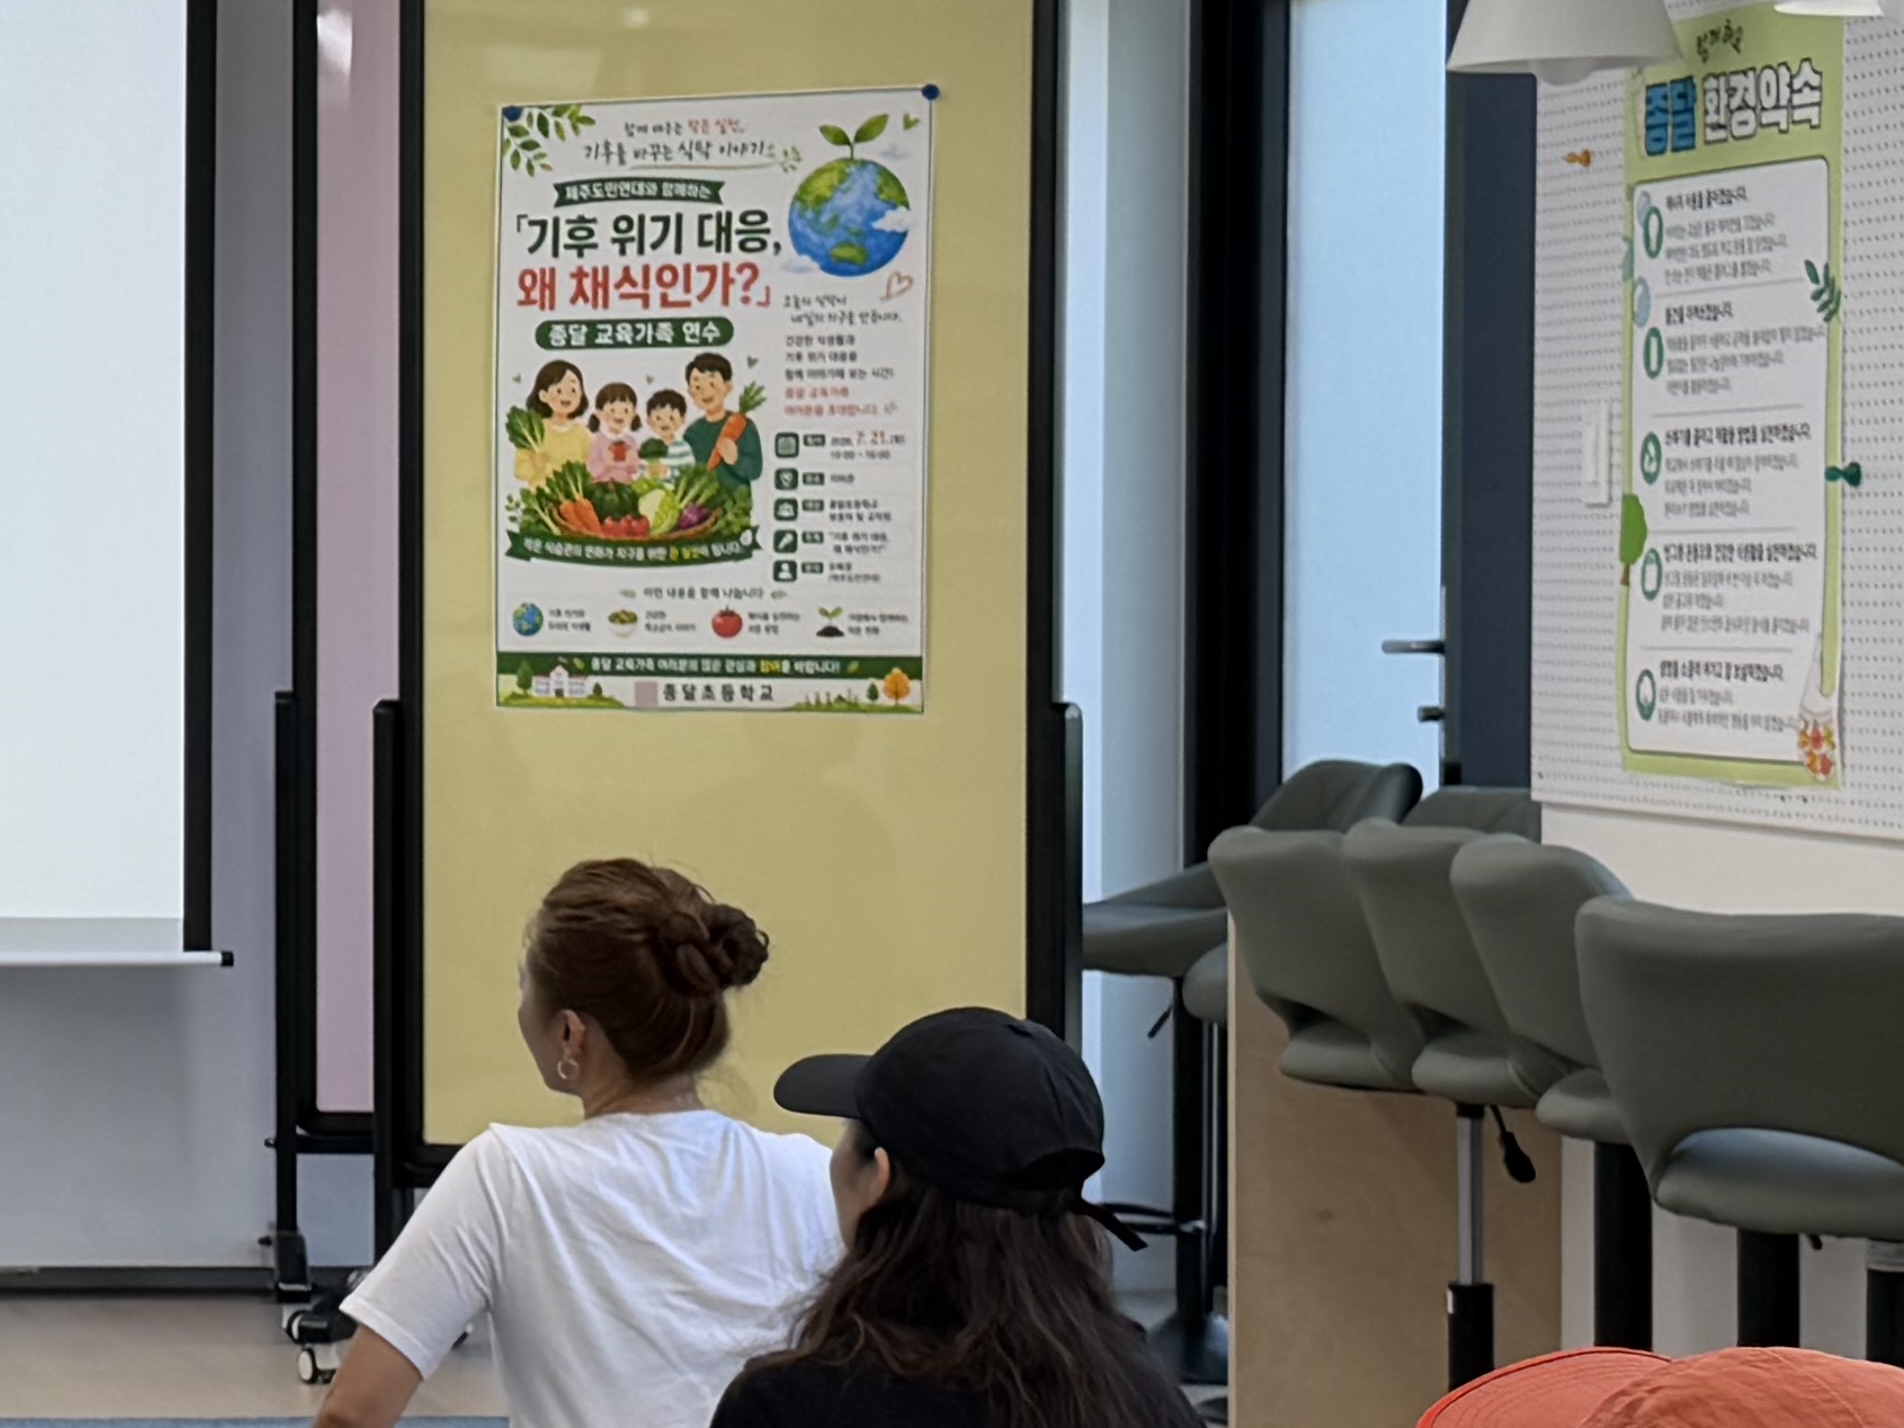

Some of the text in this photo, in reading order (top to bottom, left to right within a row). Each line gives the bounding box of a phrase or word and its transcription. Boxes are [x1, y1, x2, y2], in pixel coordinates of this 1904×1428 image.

[1644, 57, 1824, 157] 종달 환경약속
[678, 141, 712, 161] 식탁
[516, 209, 782, 259] 「기후 위기 대응,
[517, 261, 771, 311] 왜 채식인가?」
[548, 321, 721, 347] 종달 교육가족 연수
